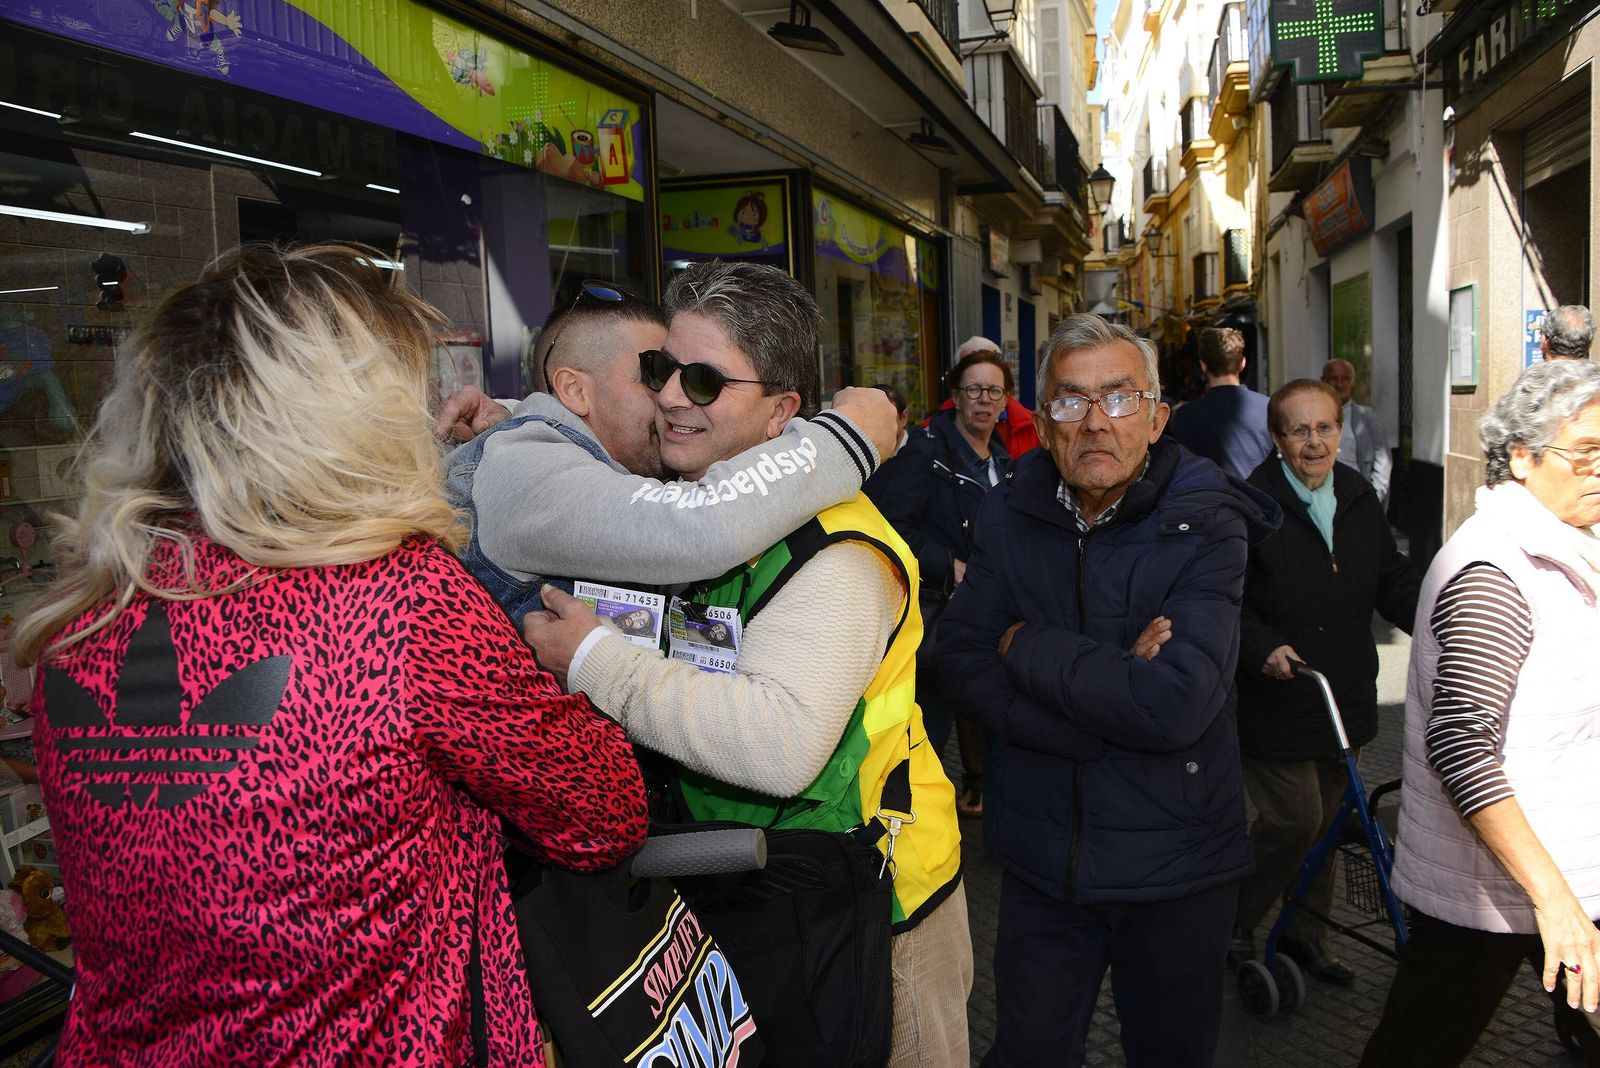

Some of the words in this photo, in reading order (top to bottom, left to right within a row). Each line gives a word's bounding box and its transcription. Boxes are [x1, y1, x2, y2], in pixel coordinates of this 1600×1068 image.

[609, 143, 618, 165] A
[630, 436, 818, 510] displacement
[625, 593, 659, 607] 71453
[709, 657, 736, 671] 86506
[643, 909, 704, 1019] SIMPLIFY
